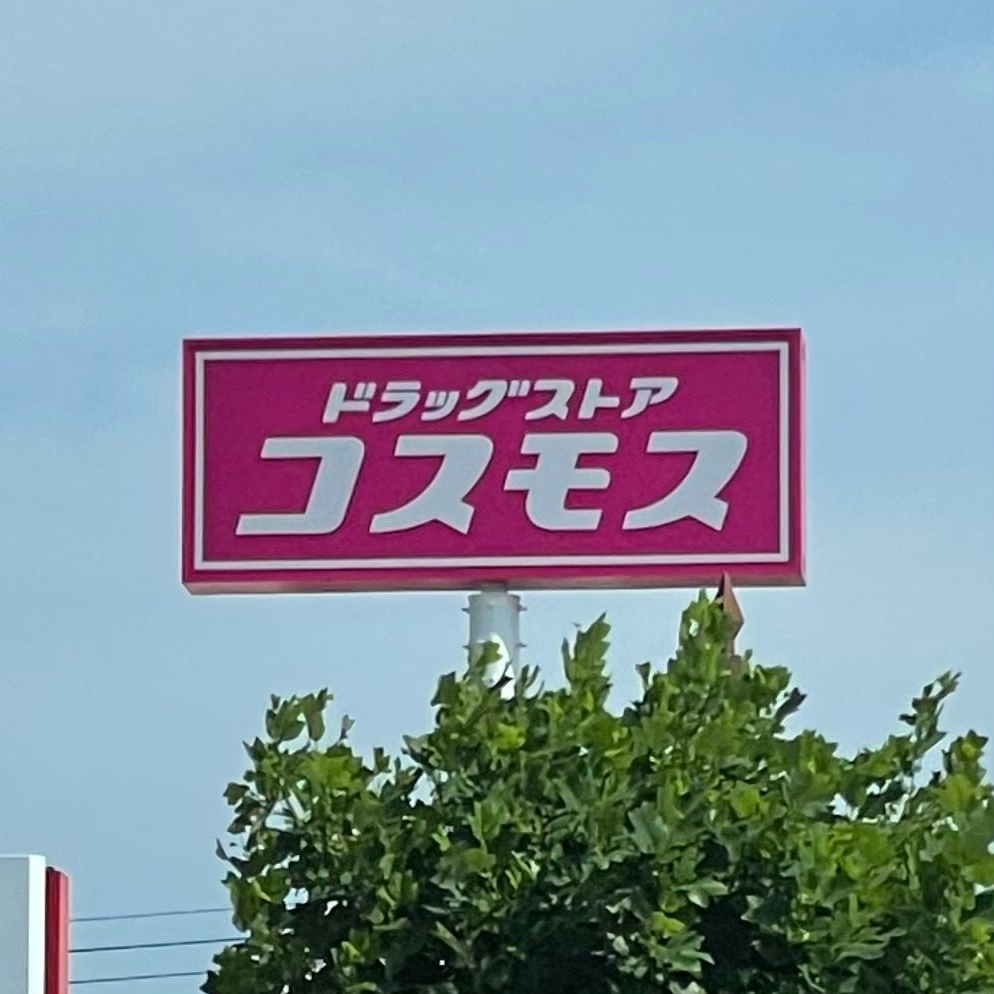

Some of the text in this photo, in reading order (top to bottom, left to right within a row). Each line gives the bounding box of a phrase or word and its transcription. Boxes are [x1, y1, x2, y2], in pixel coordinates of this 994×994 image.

[322, 377, 679, 423] ドラッグストア
[235, 430, 748, 535] コスモス
